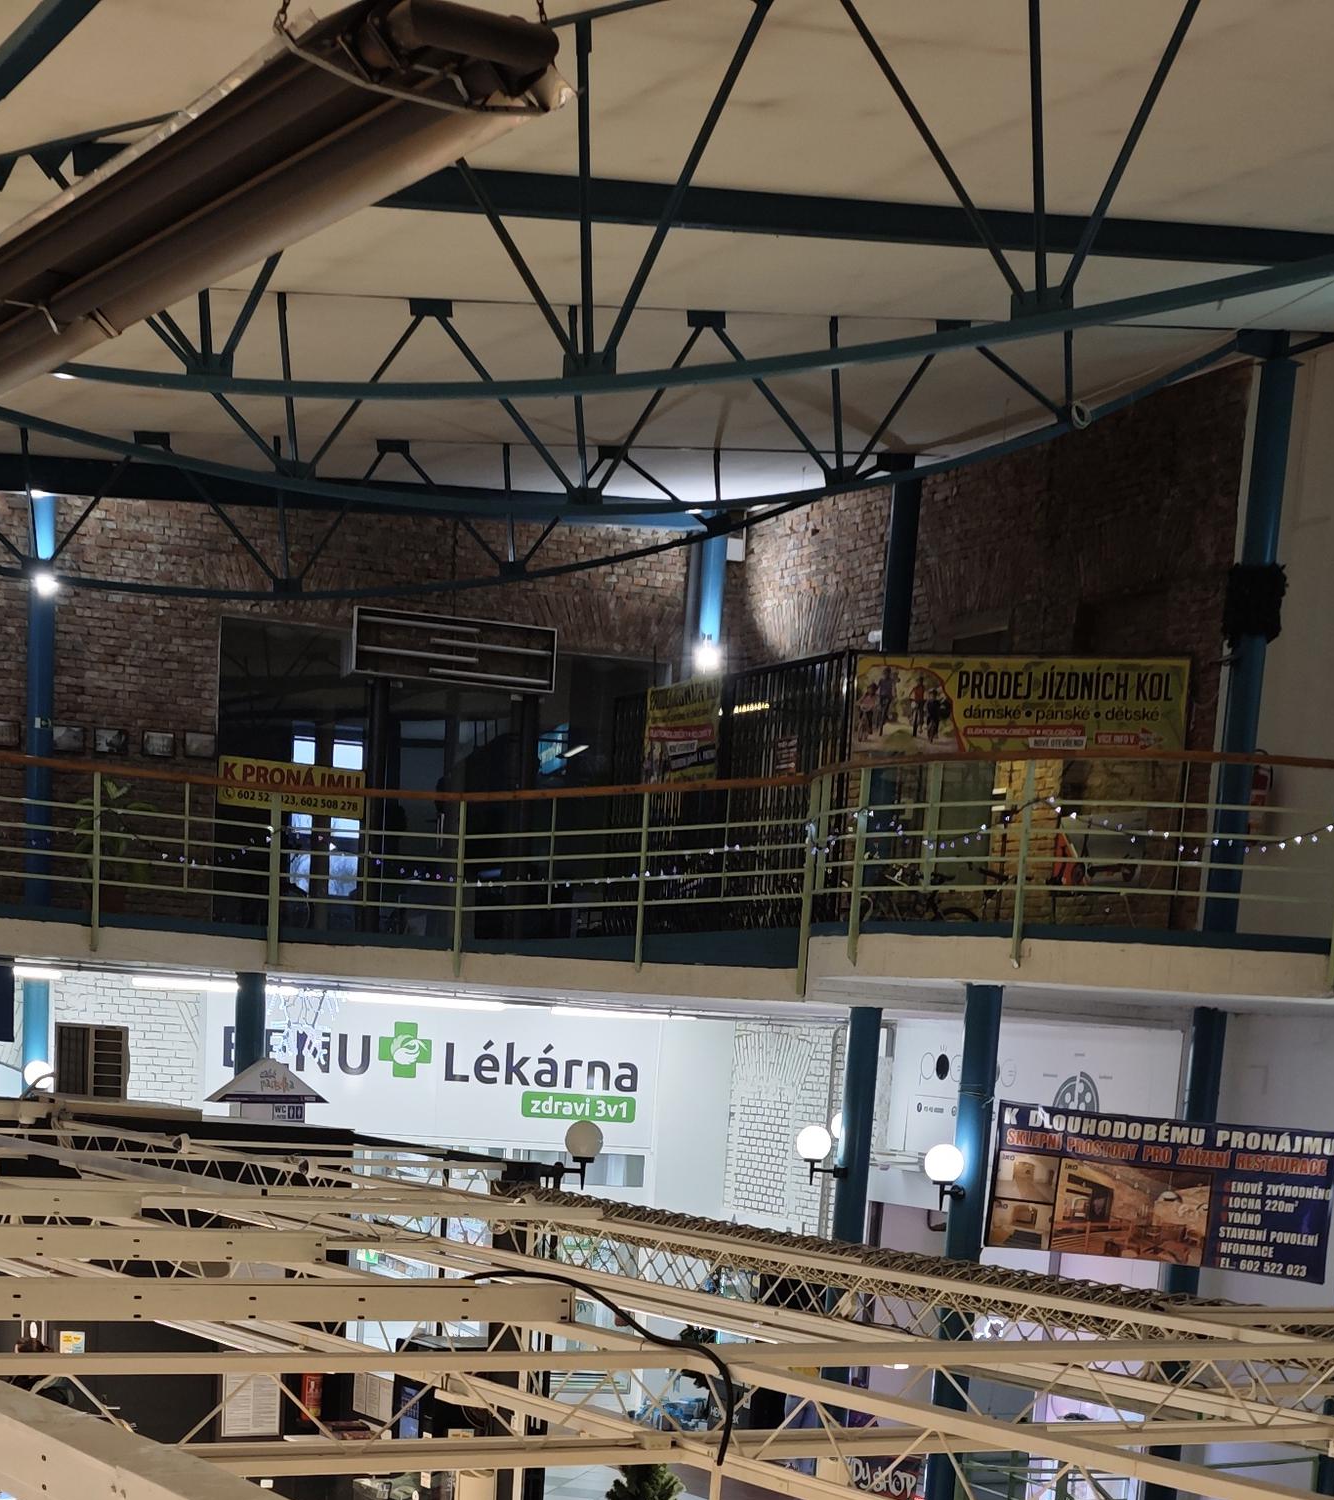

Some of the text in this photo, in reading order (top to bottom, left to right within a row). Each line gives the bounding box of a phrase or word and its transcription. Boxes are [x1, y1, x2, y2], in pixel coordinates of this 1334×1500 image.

[957, 664, 1173, 702] PRODEJ JÍZDNÍCH KOL
[963, 705, 1021, 720] dámské
[1035, 704, 1090, 723] pánské
[223, 761, 238, 781] K
[237, 790, 255, 801] 602
[281, 795, 299, 807] 23,
[300, 796, 318, 808] 602
[320, 798, 339, 810] 508
[340, 800, 358, 812] 278
[444, 1039, 640, 1093] Lékárna
[274, 1104, 286, 1113] WC
[594, 1101, 629, 1118] 3v1
[1004, 1107, 1017, 1124] K
[1029, 1109, 1206, 1147] DLOUHODOBÉMU
[1006, 1127, 1063, 1150] SKLEPNÍ
[1066, 1137, 1137, 1161] PROSTORY
[1142, 1145, 1171, 1163] PRO
[1235, 1155, 1328, 1177] RESTAURACE
[1218, 1225, 1319, 1247] STAVEBNÍ POVOLENÍ
[1239, 1259, 1260, 1272] 602
[1263, 1261, 1284, 1274] 522
[1286, 1264, 1307, 1277] 023
